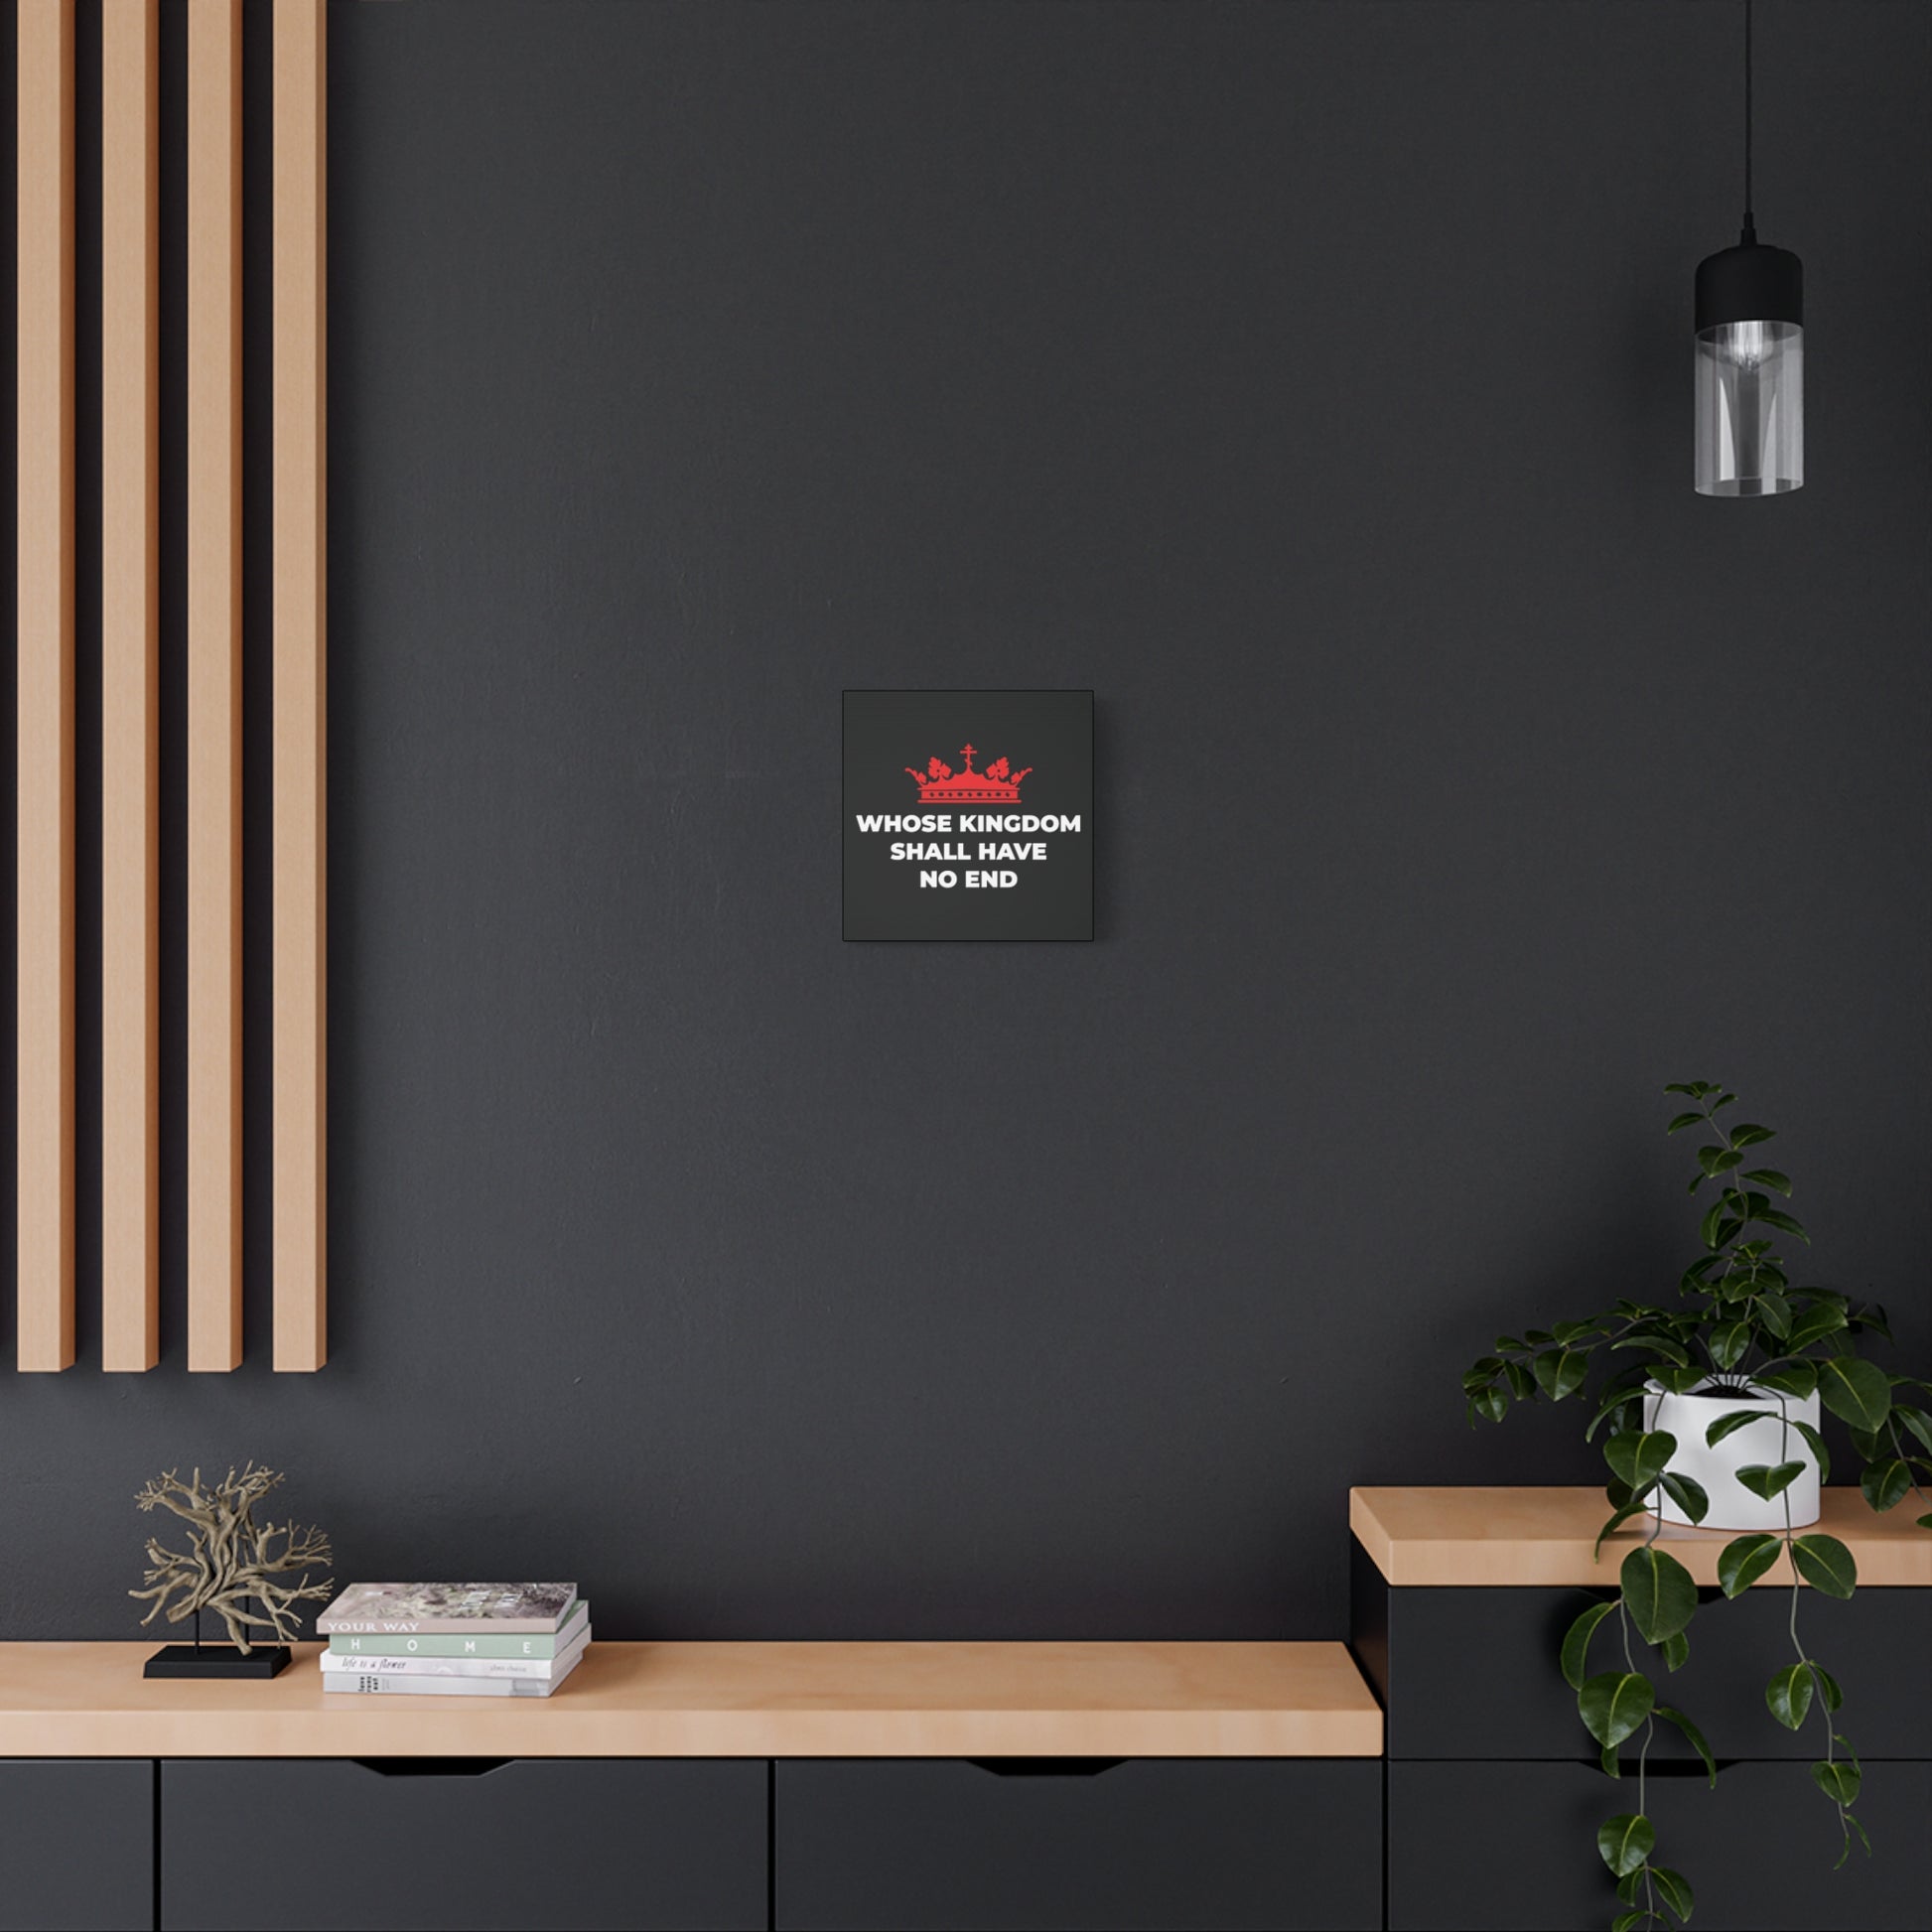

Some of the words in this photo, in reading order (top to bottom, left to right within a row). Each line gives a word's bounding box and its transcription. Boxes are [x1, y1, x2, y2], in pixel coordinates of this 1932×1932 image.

[856, 814, 952, 833] WHOSE
[959, 814, 1081, 833] KINGDOM
[890, 842, 972, 861] SHALL
[978, 842, 1047, 861] HAVE
[919, 870, 957, 889] NO
[965, 870, 1019, 889] END
[328, 1622, 375, 1632] YOUR
[383, 1622, 419, 1632] WAY
[350, 1638, 532, 1654] HOME
